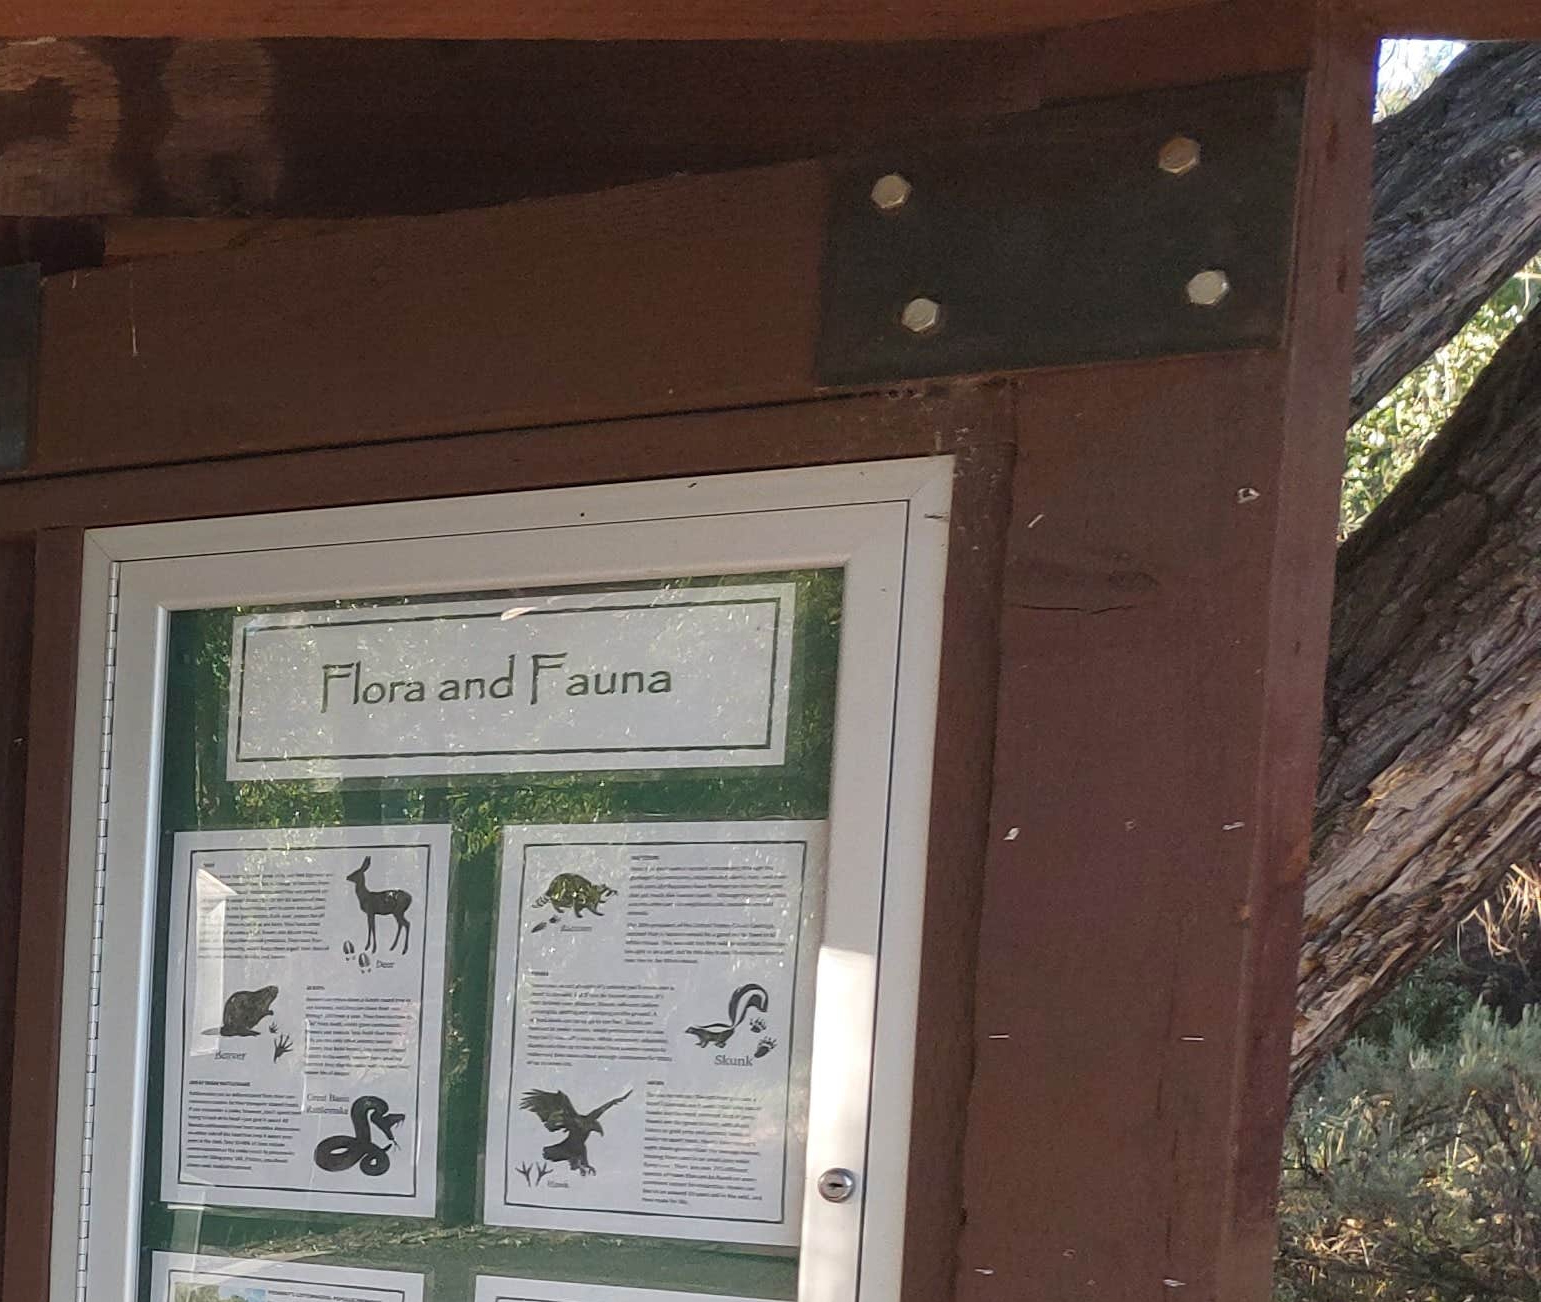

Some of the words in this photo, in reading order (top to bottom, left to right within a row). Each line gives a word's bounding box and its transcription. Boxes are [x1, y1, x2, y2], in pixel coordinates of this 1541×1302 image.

[320, 662, 425, 714] Flora
[438, 655, 515, 701] and
[529, 652, 672, 705] Fauna
[714, 1055, 753, 1067] Skunk
